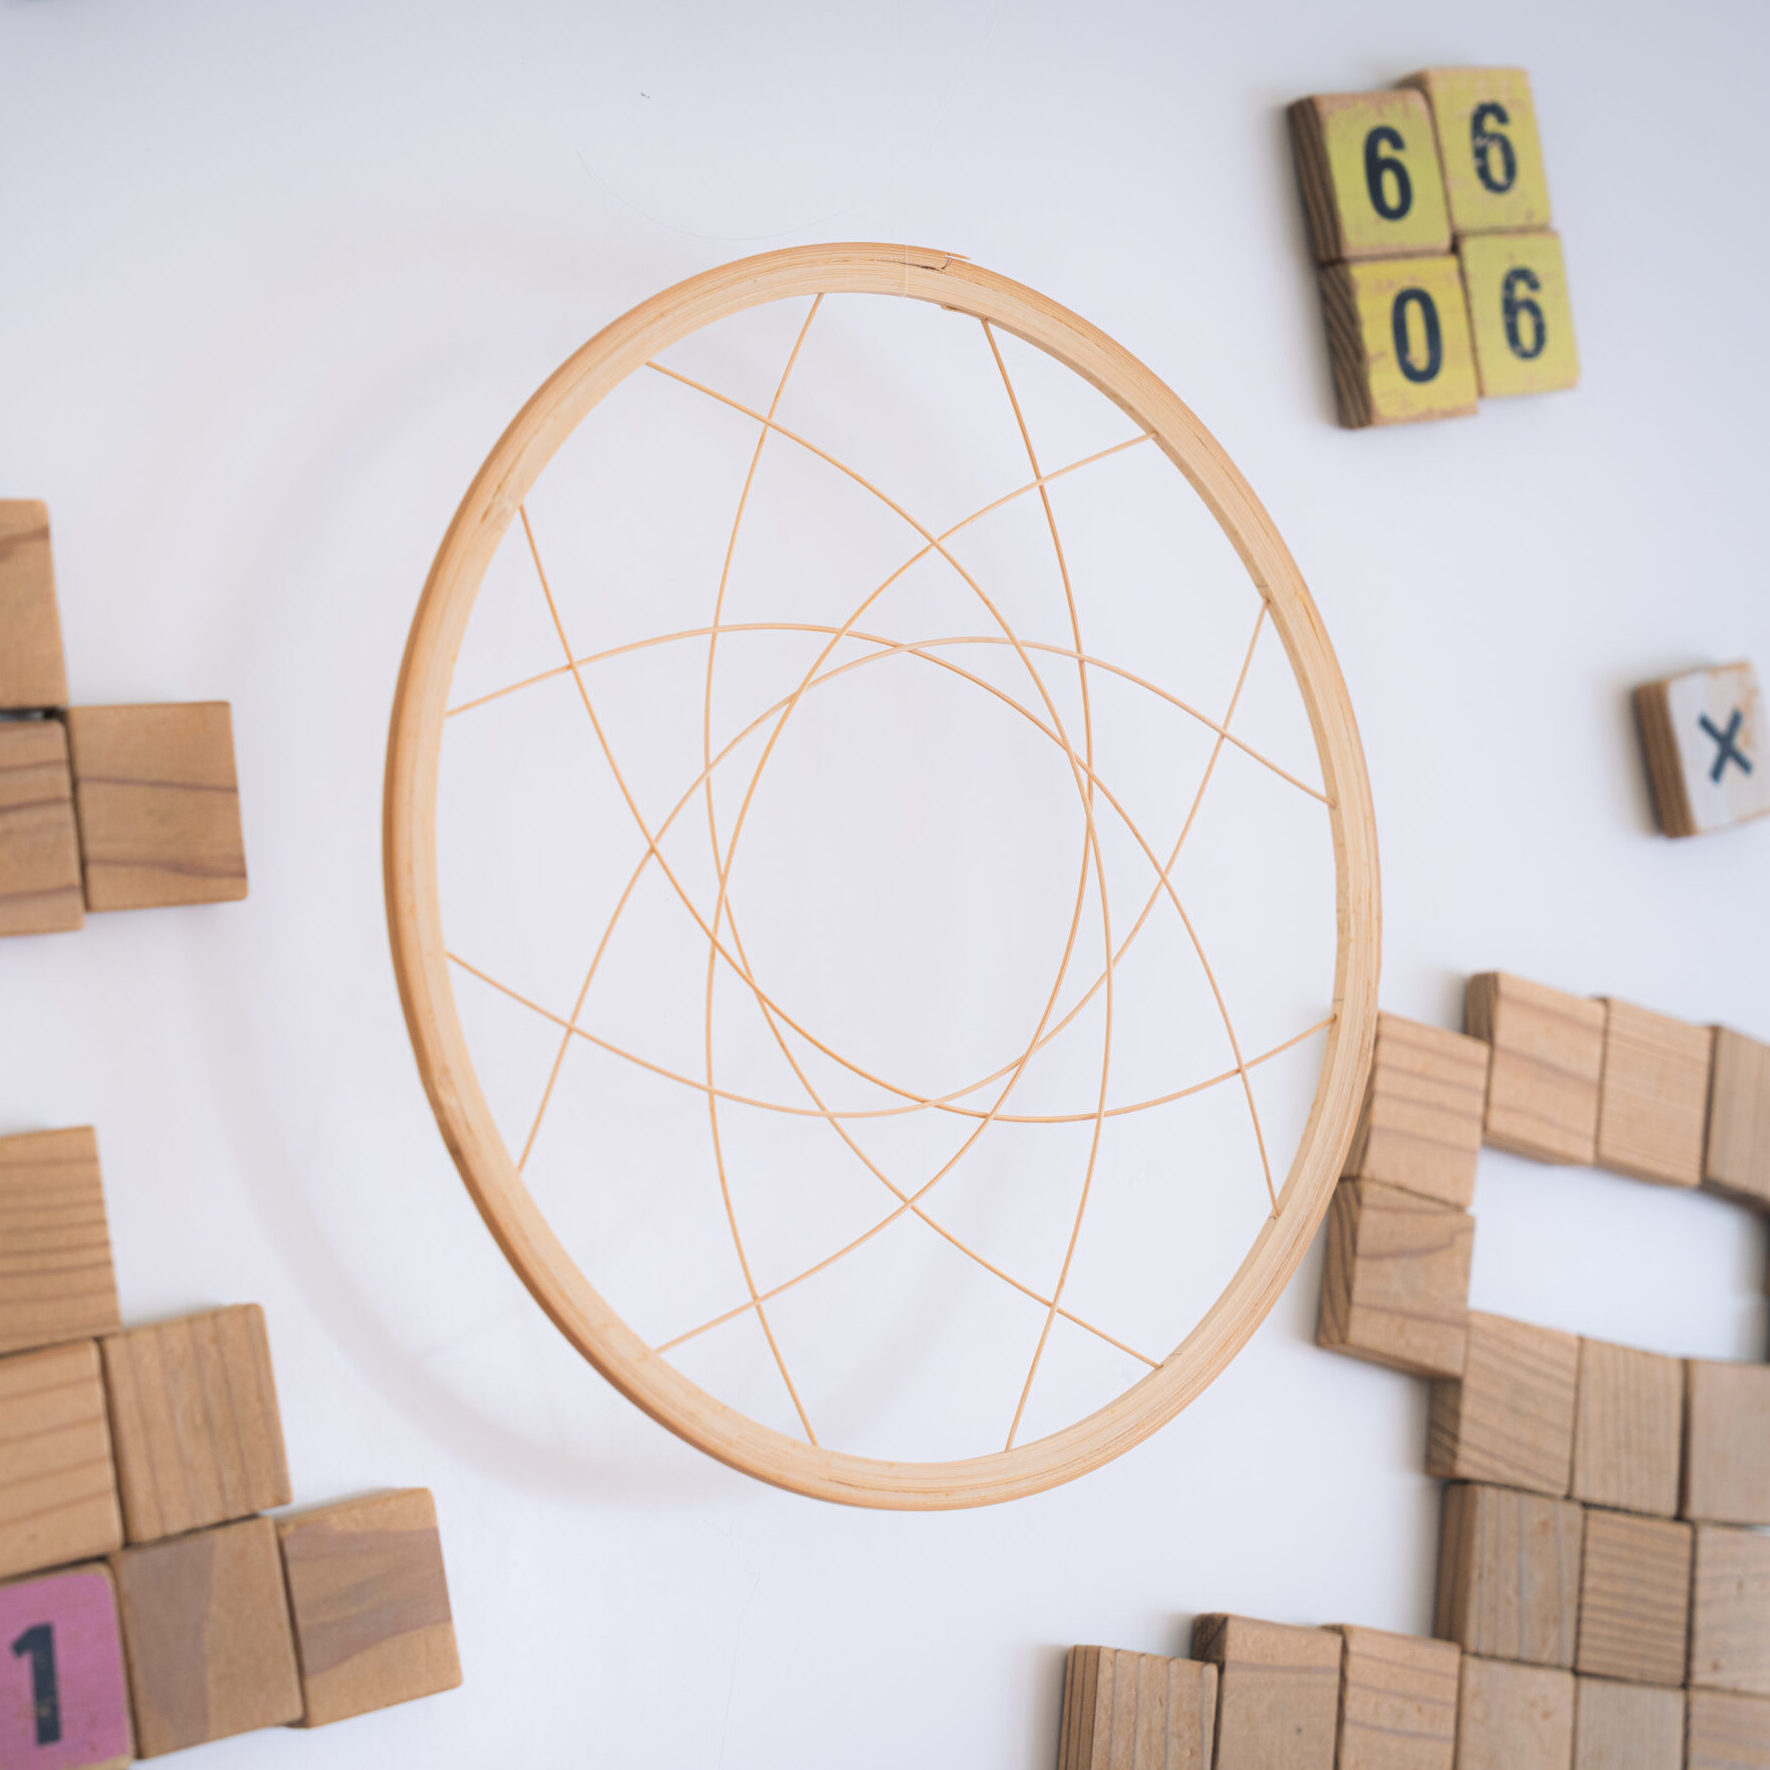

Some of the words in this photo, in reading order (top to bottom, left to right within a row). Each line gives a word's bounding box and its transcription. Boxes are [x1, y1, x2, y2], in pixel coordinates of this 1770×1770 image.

[1363, 125, 1413, 221] 6
[1471, 102, 1517, 194] 6
[1502, 267, 1546, 360] 6
[11, 1622, 63, 1747] 1
